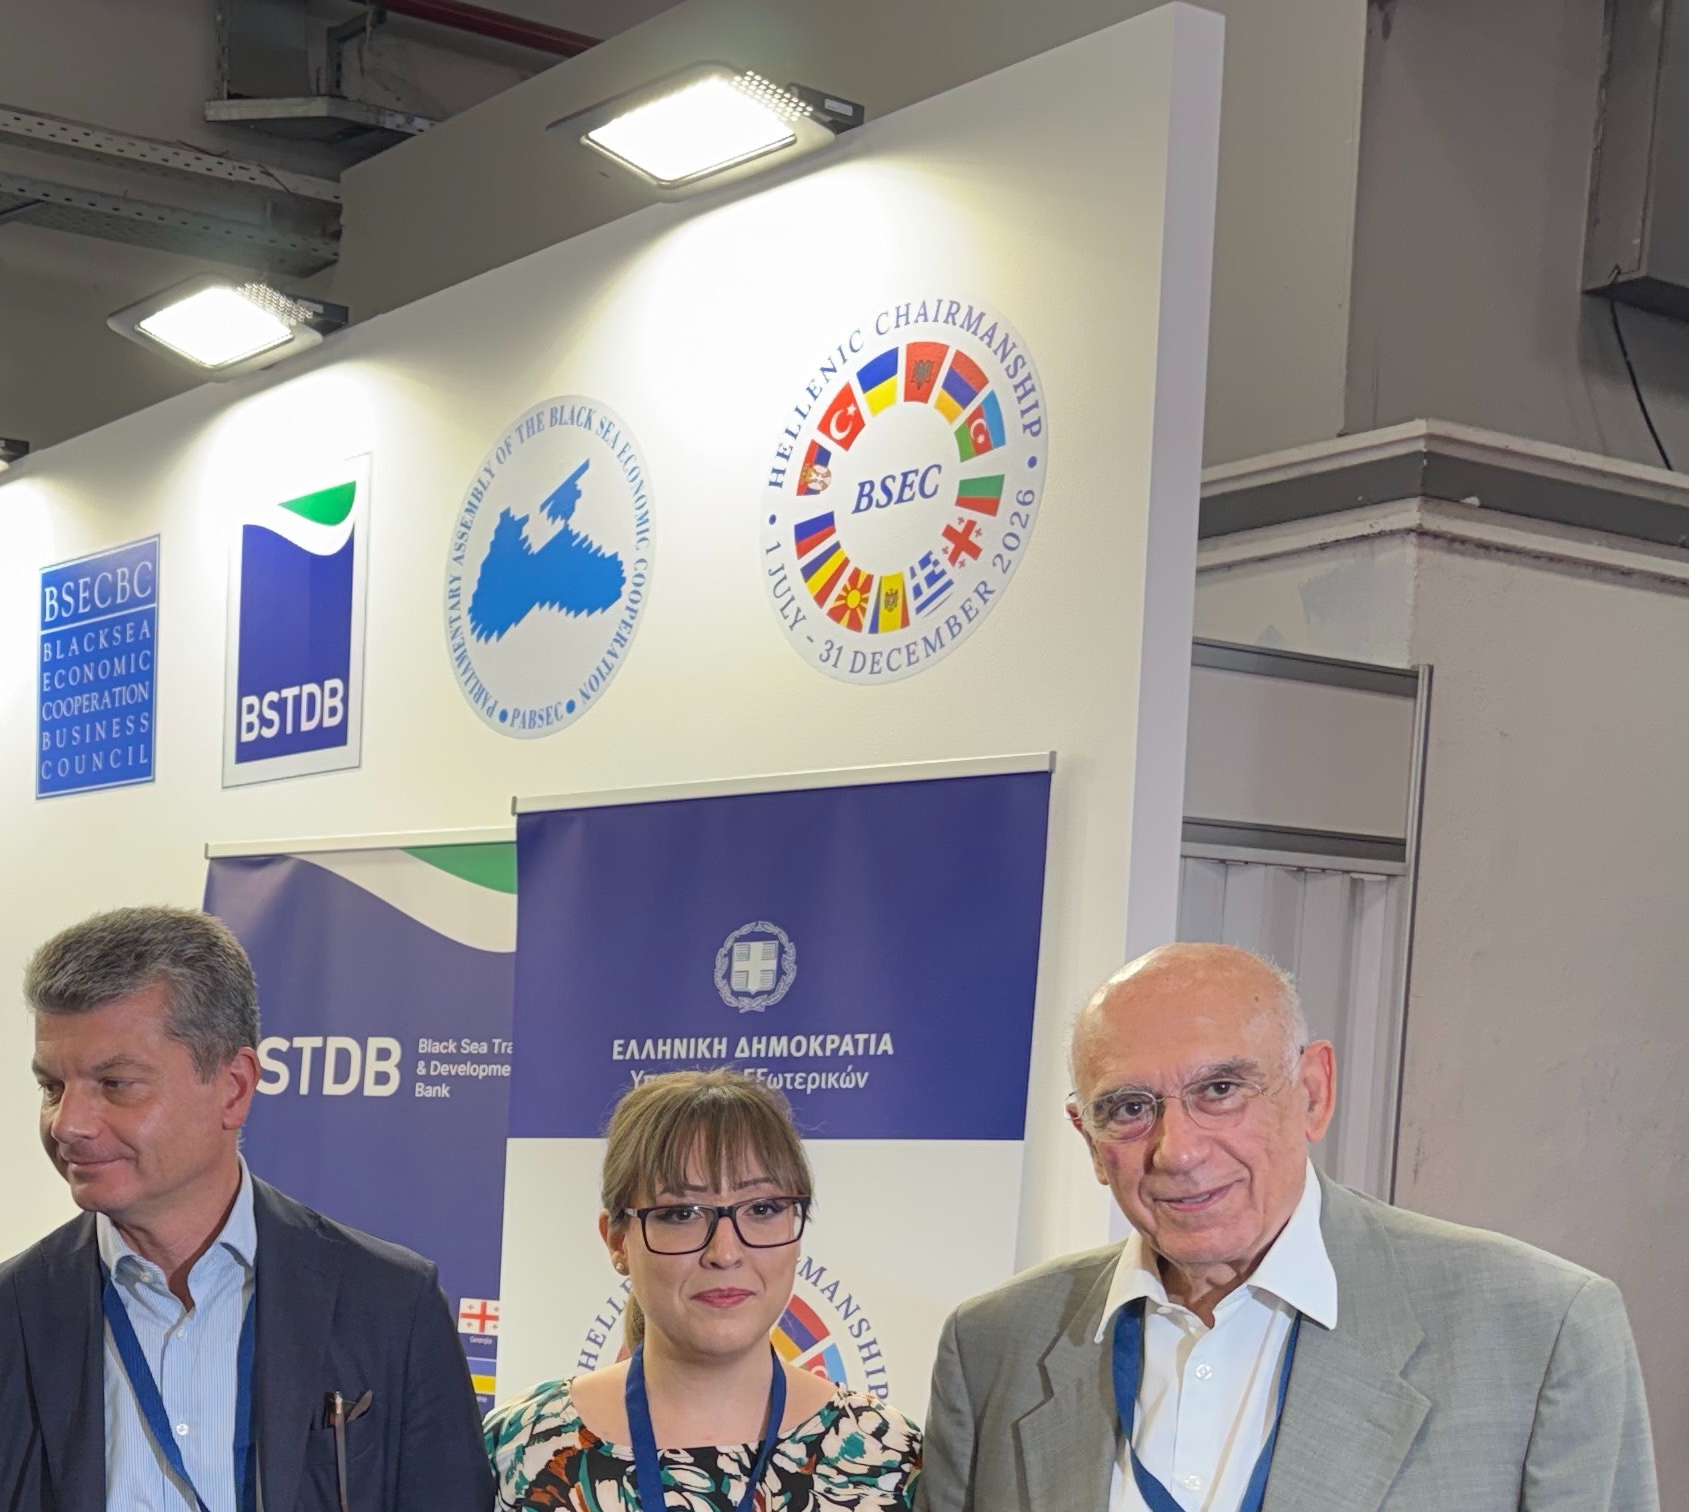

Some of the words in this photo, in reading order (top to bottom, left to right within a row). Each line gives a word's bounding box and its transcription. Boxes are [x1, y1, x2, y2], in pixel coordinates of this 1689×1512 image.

[768, 329, 865, 489] HELLENIC
[875, 298, 1043, 438] CHAIRMANSHIP
[515, 411, 545, 445] THE
[549, 404, 597, 431] BLACK
[596, 415, 621, 450] SEA
[495, 435, 512, 465] OF
[615, 441, 651, 551] ECONOMIC
[851, 463, 943, 514] BSEC
[452, 460, 496, 566] ASSEMBLY
[992, 489, 1036, 575] 2026
[765, 541, 781, 556] 1
[44, 560, 153, 623] BSECBC
[767, 563, 807, 631] JULY
[43, 618, 151, 662] BLACKSEA
[448, 574, 499, 719] PARLIAMENTARY
[577, 558, 649, 705] COOPERATION
[848, 580, 997, 675] DECEMBER
[43, 650, 151, 692] ECONOMIC
[819, 639, 844, 669] 31
[42, 681, 150, 721] COOPERATION
[240, 678, 344, 743] BSTDB
[509, 701, 564, 729] PABSEC
[42, 712, 150, 751] BUSINESS
[41, 744, 149, 780] COUNCIL
[256, 1036, 402, 1097] STDB
[418, 1038, 457, 1054] Black
[460, 1038, 488, 1054] Sea
[612, 1036, 728, 1061] ΕΛΛΗΝΙΚΗ
[734, 1032, 895, 1059] ΔΗΜΟΚΡΑΤΙΑ
[414, 1082, 451, 1098] Bank
[416, 1060, 427, 1075] &
[429, 1060, 511, 1080] Developme
